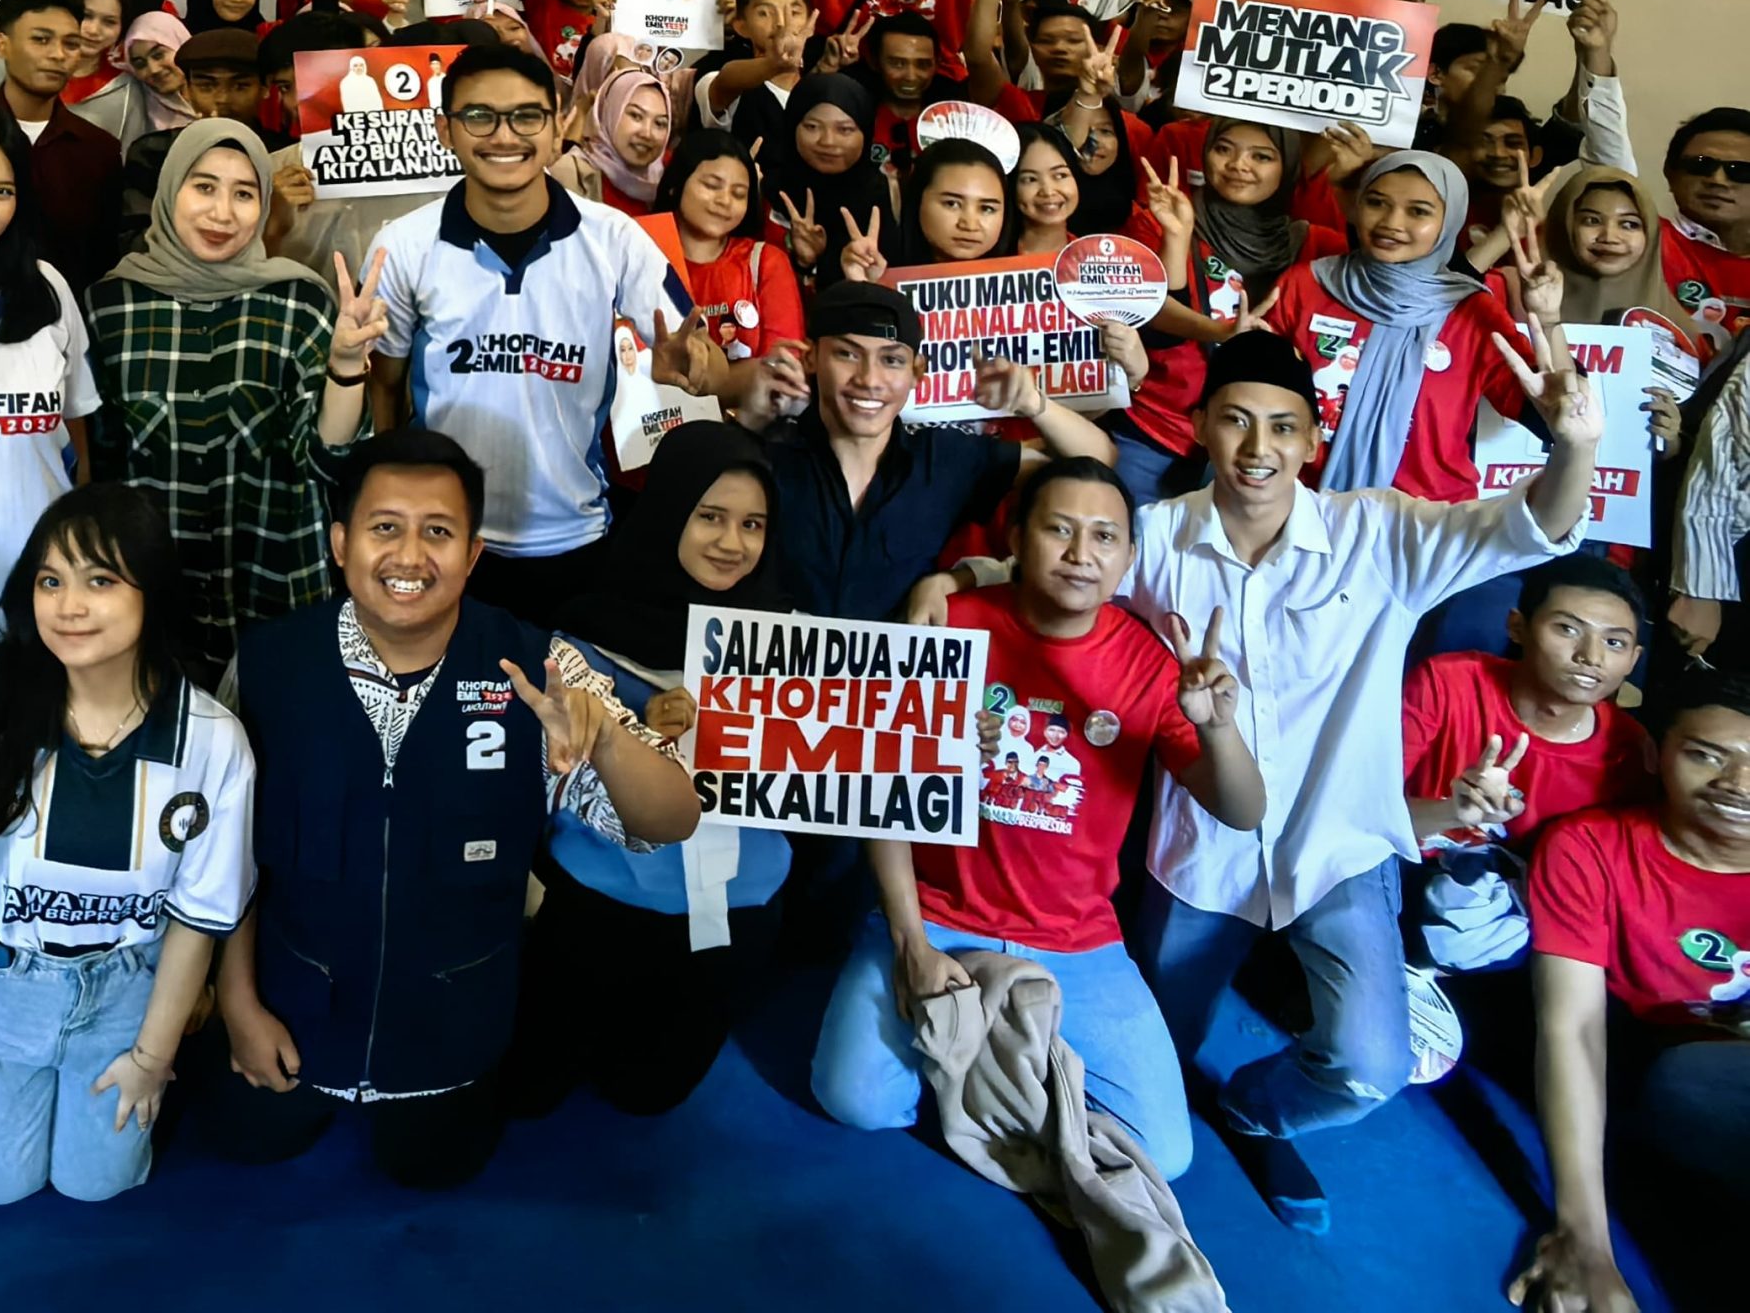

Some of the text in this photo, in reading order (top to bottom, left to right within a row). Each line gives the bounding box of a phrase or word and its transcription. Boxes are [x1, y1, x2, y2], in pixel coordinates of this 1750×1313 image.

[1216, 0, 1400, 53] MENANG
[1196, 25, 1409, 95] MUTLAK
[395, 71, 412, 93] 2
[1207, 67, 1388, 119] 2 PERIODE
[336, 112, 365, 130] KE
[318, 145, 370, 164] AYO
[369, 142, 400, 161] BU
[323, 161, 378, 180] KITA
[1079, 264, 1141, 275] KHOFIFAH
[1080, 275, 1107, 285] EMIL
[1208, 256, 1226, 276] 2
[900, 278, 971, 313] TUKU
[1686, 281, 1705, 305] 2
[928, 301, 1074, 341] MANALAGI,
[446, 338, 474, 374] 2
[477, 333, 586, 365] KHOFIFAH
[1043, 327, 1101, 363] EMIL
[1322, 334, 1340, 352] 2
[472, 353, 576, 381] EMIL 2024
[1045, 360, 1107, 395] LAGI
[7, 418, 57, 435] 2024
[703, 617, 972, 679] SALAM DUA JARI
[456, 680, 512, 692] KHOFIFAH
[456, 691, 481, 702] EMIL
[988, 686, 1010, 716] 2
[700, 675, 968, 740] KHOFIFAH
[466, 721, 506, 770] 2
[693, 708, 964, 774] EMIL
[693, 771, 851, 826] SEKALI
[859, 774, 964, 836] LAGI
[1691, 931, 1732, 964] 2
